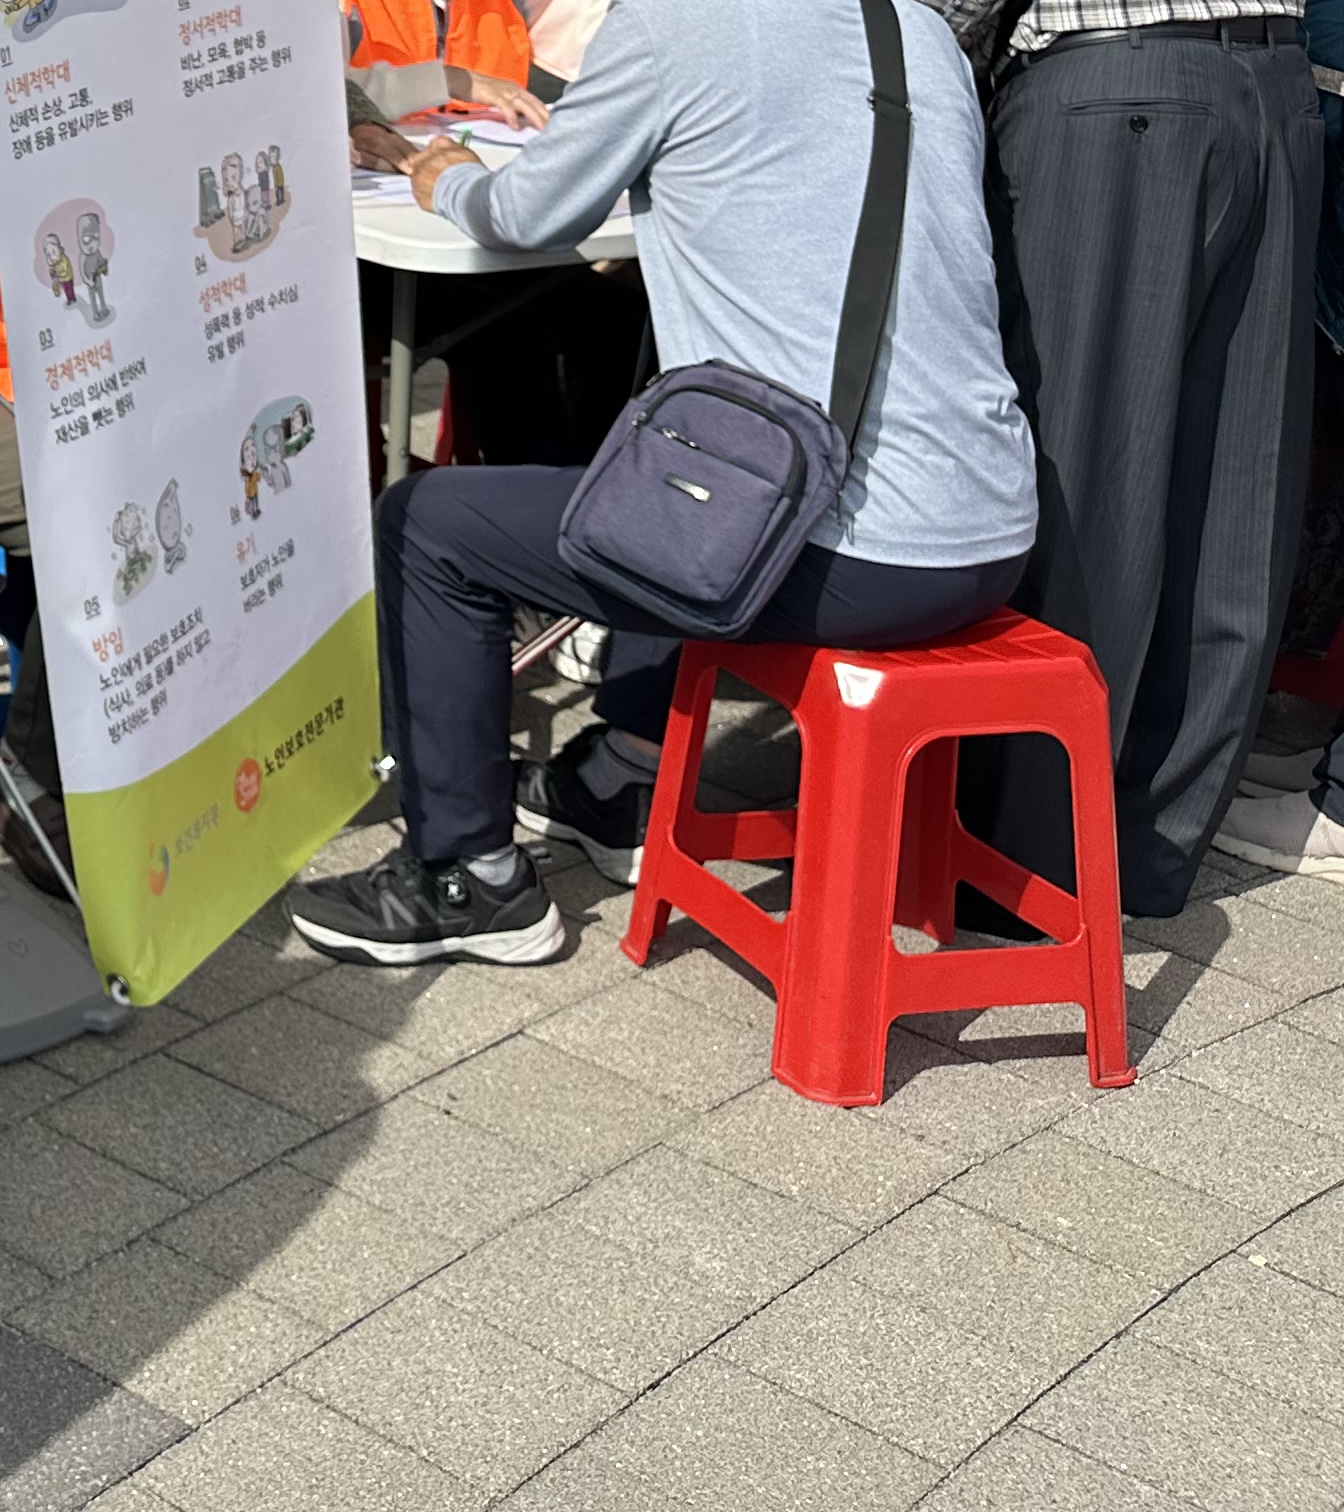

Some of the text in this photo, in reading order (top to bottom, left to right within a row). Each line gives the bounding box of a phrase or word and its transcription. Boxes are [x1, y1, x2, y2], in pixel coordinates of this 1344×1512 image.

[179, 5, 243, 46] 정서적학대
[0, 46, 13, 67] 01
[183, 45, 292, 98] 정서적 고통을 주는 행위
[4, 58, 71, 105] 신체적학대
[9, 105, 40, 133] 신체적
[35, 126, 55, 151] 등을
[58, 108, 110, 142] 유발시키는
[112, 97, 134, 122] 행위
[199, 271, 247, 313] 성적학대
[39, 327, 55, 351] 03
[45, 338, 115, 391] 경제적학대
[50, 388, 86, 419] 노인의
[55, 415, 90, 444] 재산을
[84, 596, 101, 620] 05
[92, 627, 124, 662] 방임
[99, 652, 142, 691] 노인에게
[264, 696, 345, 777] 노인보호전문기관
